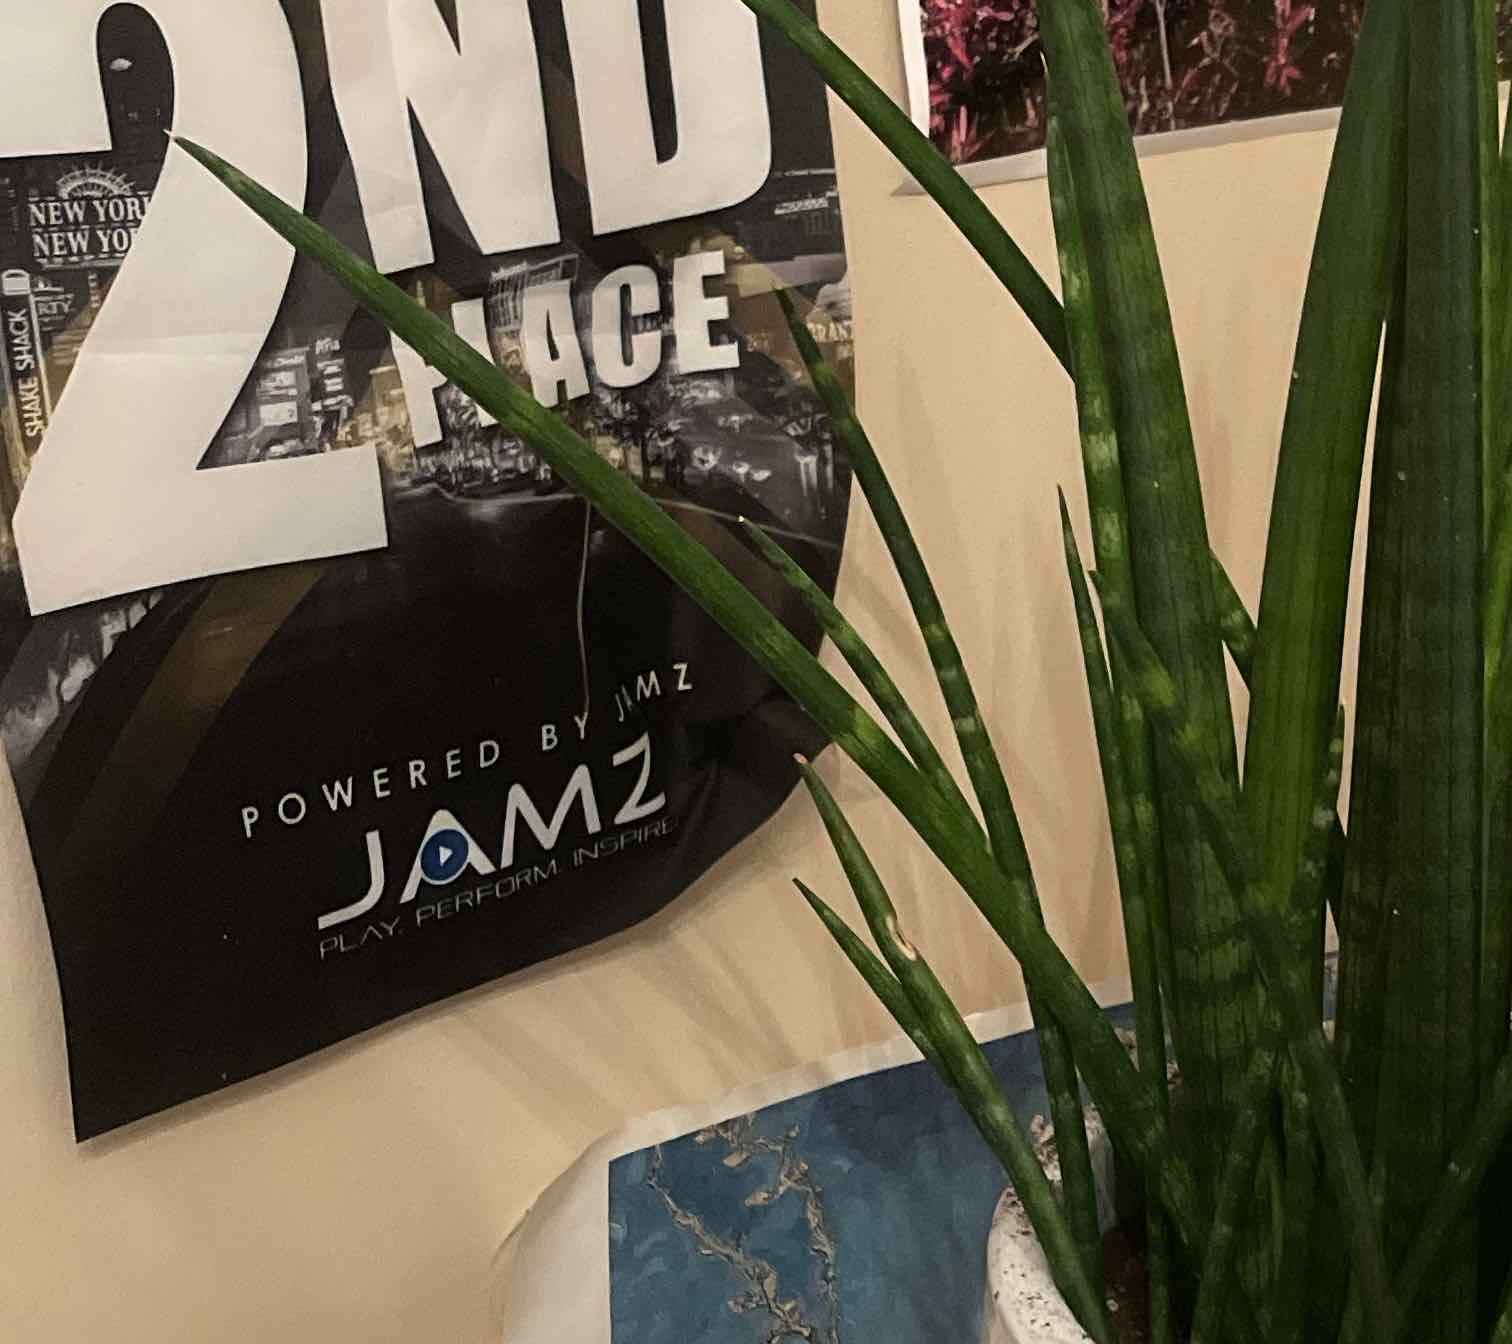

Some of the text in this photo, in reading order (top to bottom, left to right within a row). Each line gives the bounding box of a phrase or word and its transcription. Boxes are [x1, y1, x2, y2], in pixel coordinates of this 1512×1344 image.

[29, 198, 86, 228] NEW
[32, 229, 90, 257] NEW
[9, 308, 45, 438] SHAKE SHACK
[241, 739, 502, 839] POWERED
[541, 710, 590, 752] BY
[317, 731, 667, 931] JAMZ
